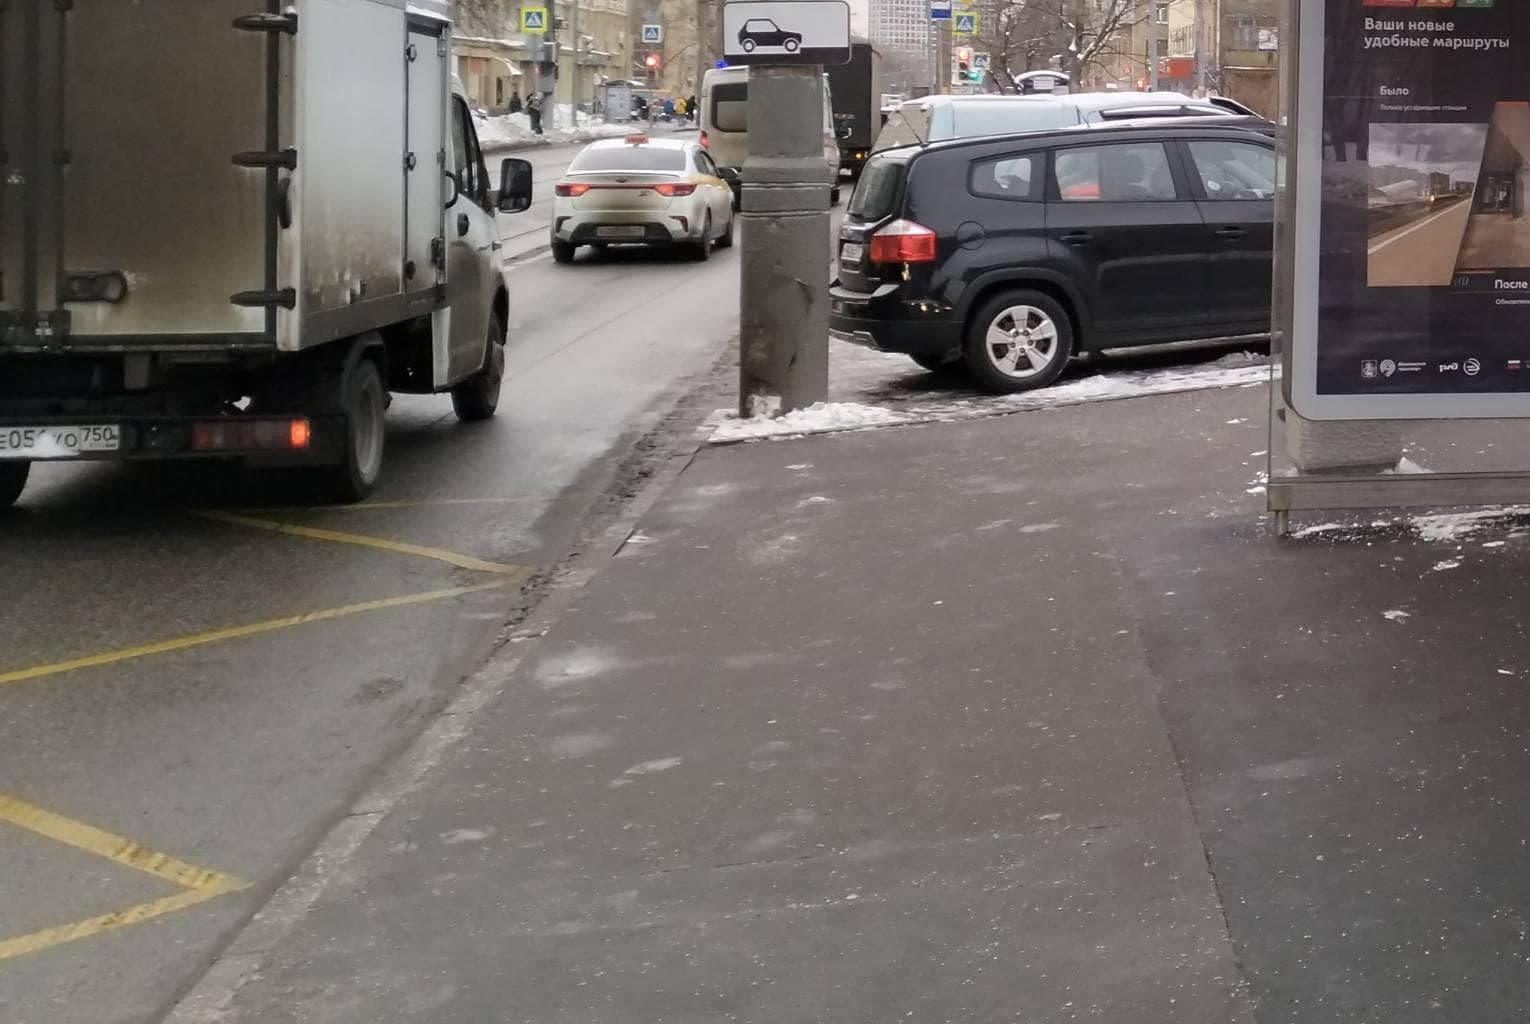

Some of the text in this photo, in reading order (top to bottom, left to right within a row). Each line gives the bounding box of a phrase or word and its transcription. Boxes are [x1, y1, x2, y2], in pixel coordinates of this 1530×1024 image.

[1364, 18, 1455, 31] Ваши новые
[1364, 35, 1510, 50] удобные маршруты
[1380, 86, 1409, 95] Было
[1495, 279, 1528, 289] После
